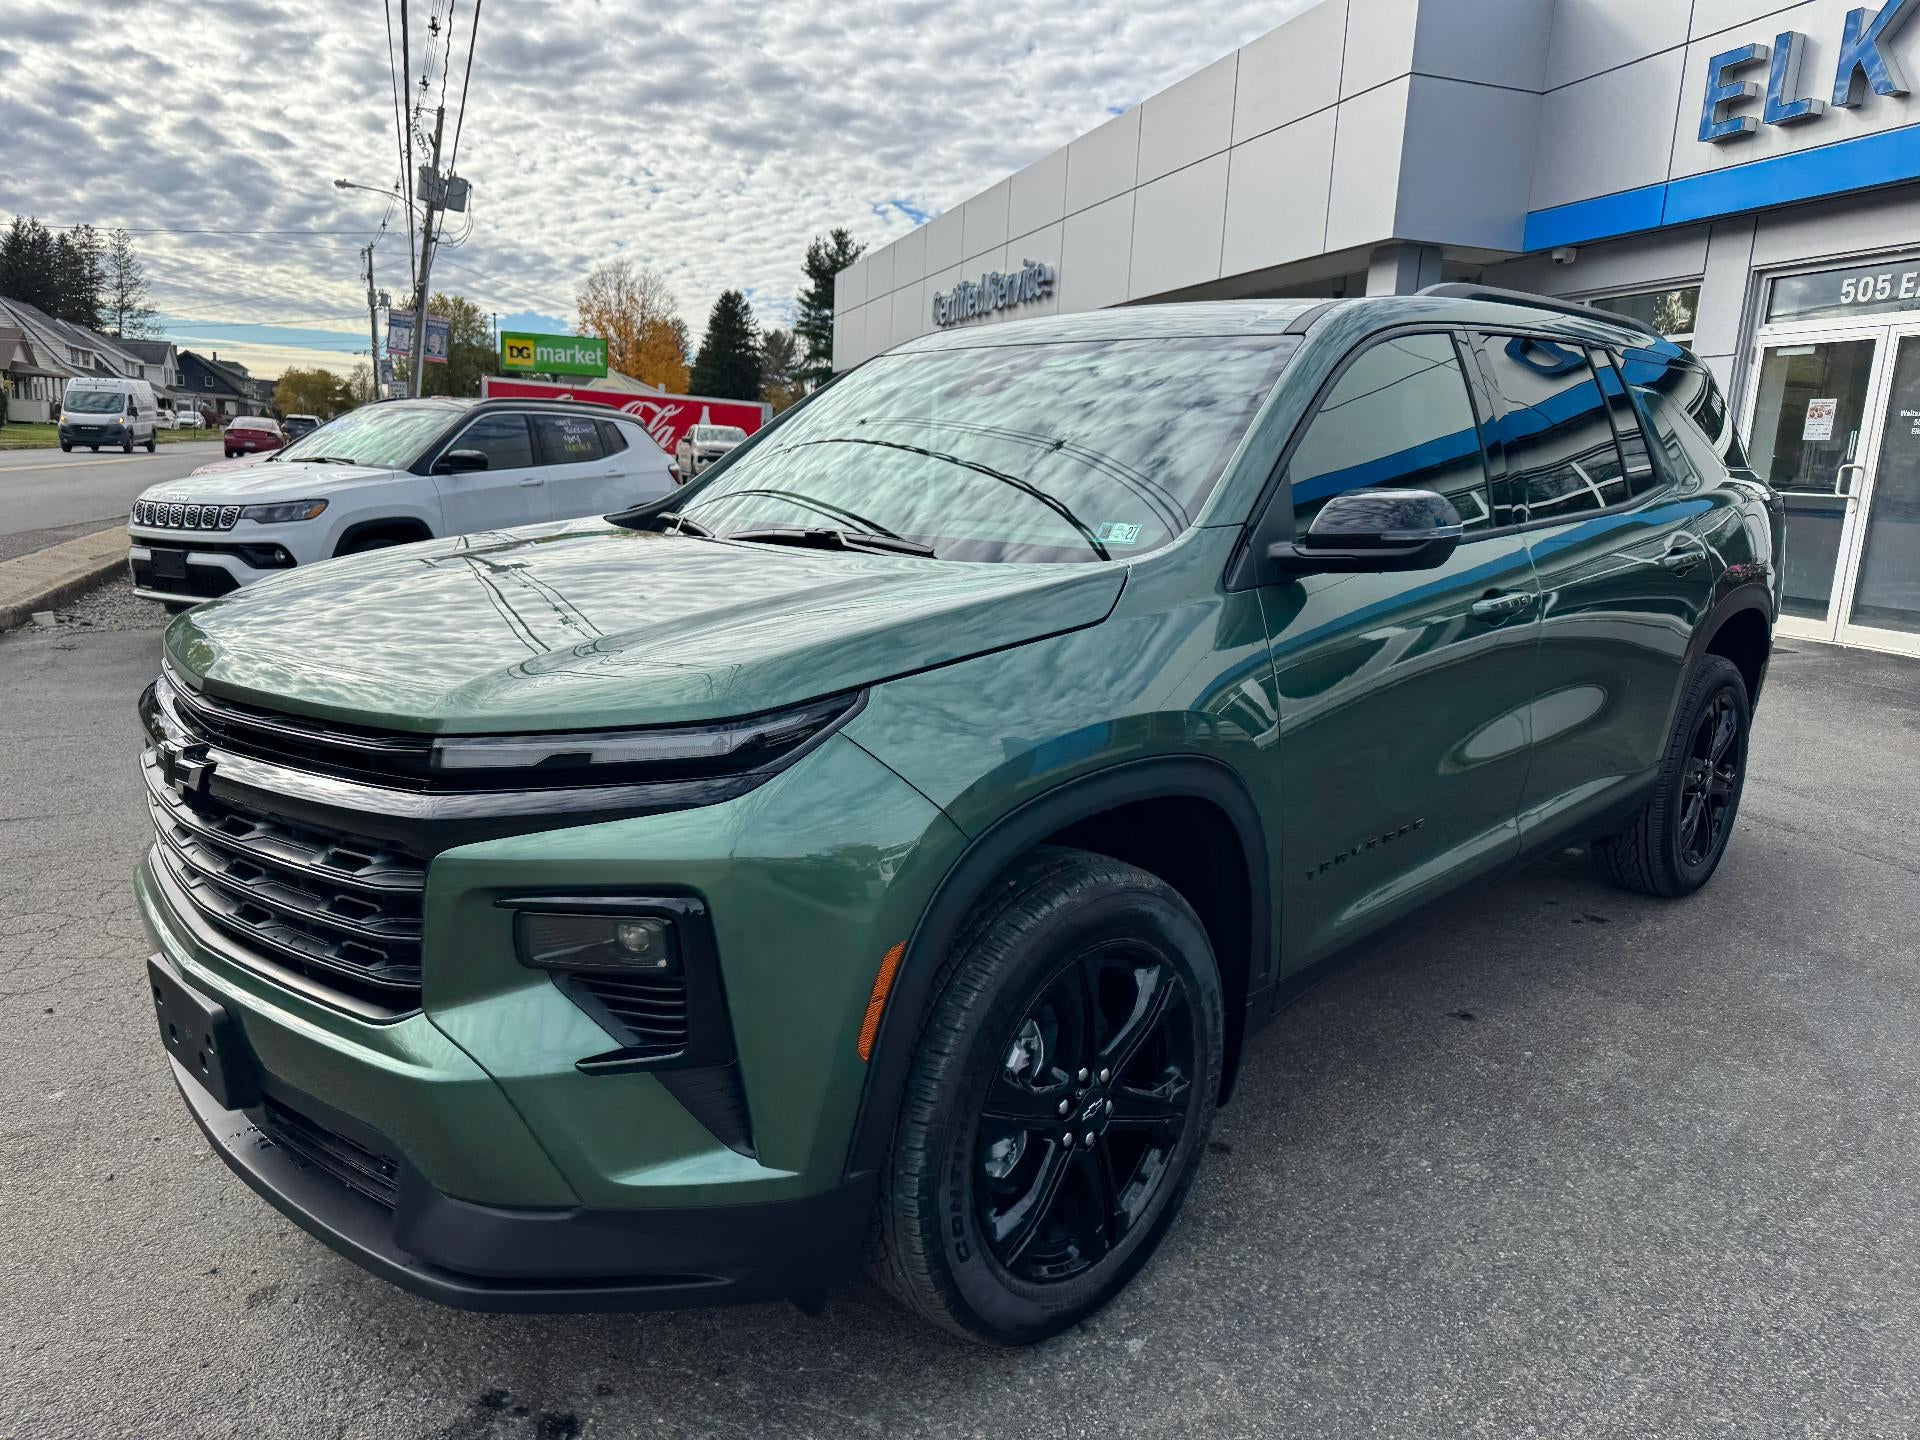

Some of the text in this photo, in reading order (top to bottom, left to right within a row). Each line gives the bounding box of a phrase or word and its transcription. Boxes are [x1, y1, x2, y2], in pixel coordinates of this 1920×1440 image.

[988, 258, 1054, 312] Service
[1839, 271, 1920, 305] 505 E
[508, 344, 604, 367] DG market
[1124, 526, 1138, 541] 27
